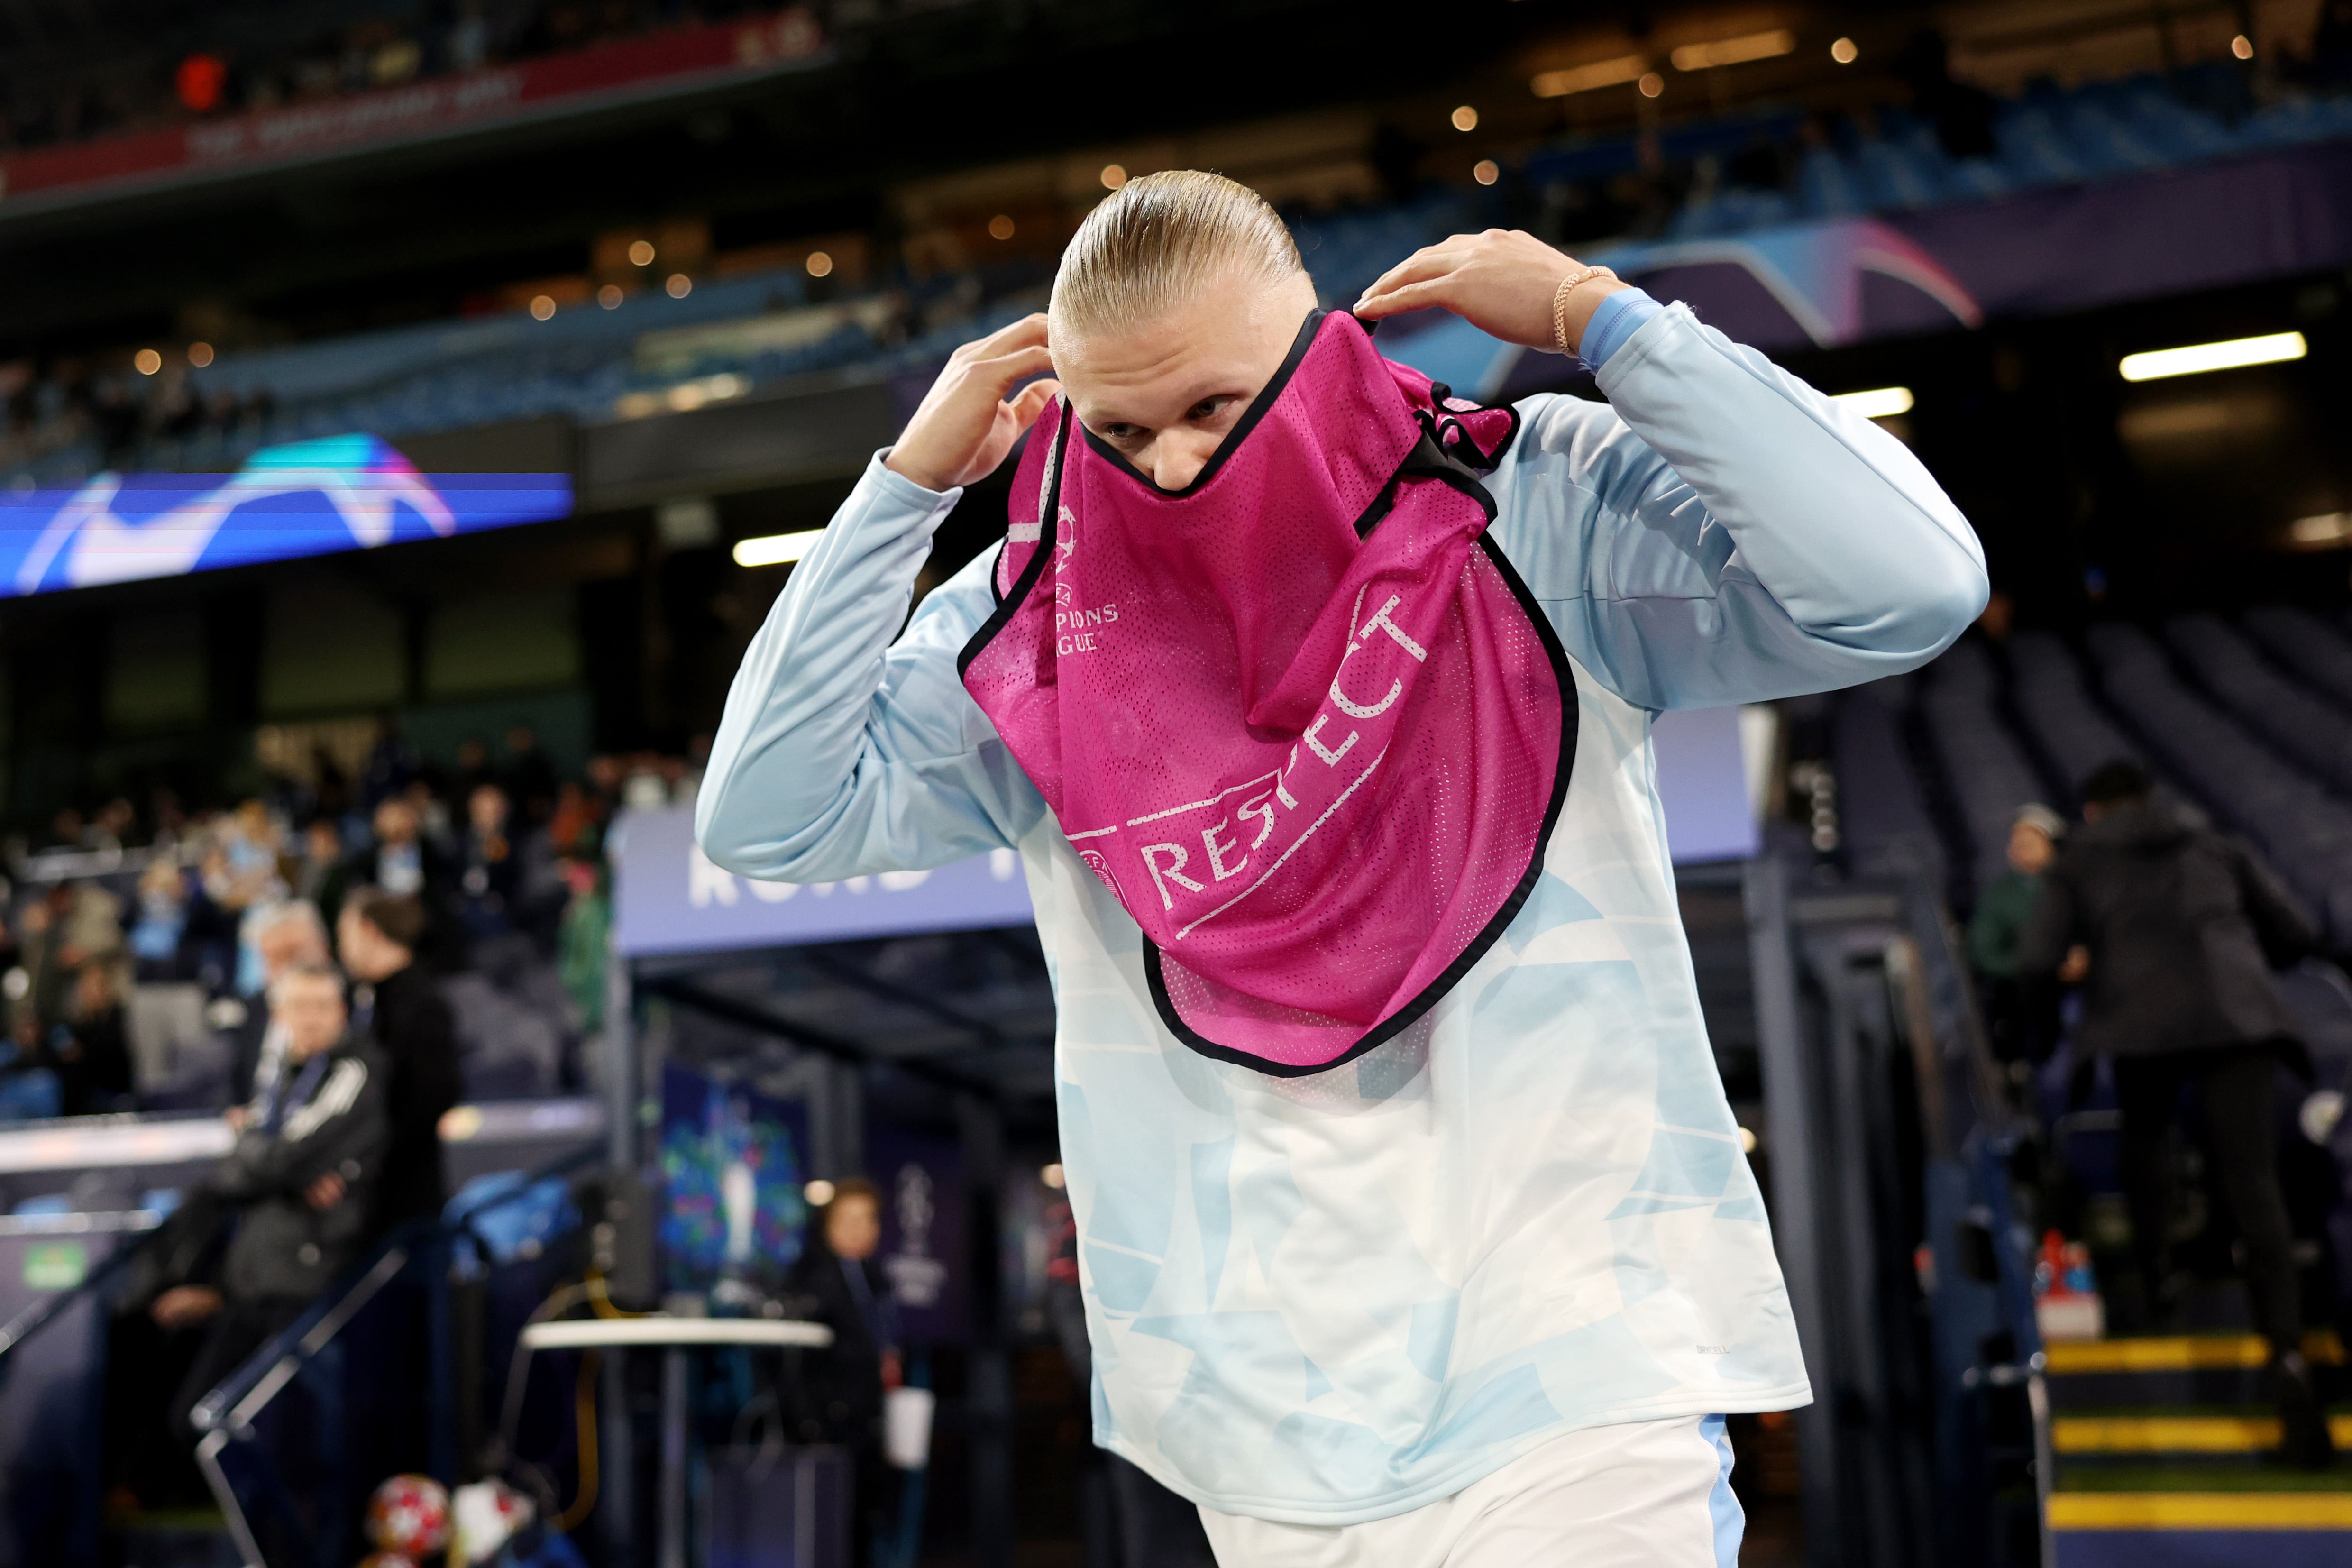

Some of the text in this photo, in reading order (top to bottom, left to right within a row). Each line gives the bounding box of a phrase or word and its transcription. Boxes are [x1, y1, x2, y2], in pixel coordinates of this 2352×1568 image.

[1056, 587, 1071, 604] FA
[1056, 604, 1118, 633] PIONS
[1056, 633, 1098, 657] GUE
[1140, 594, 1428, 911] RESPECT
[1696, 1345, 1730, 1355] DRYCELL
